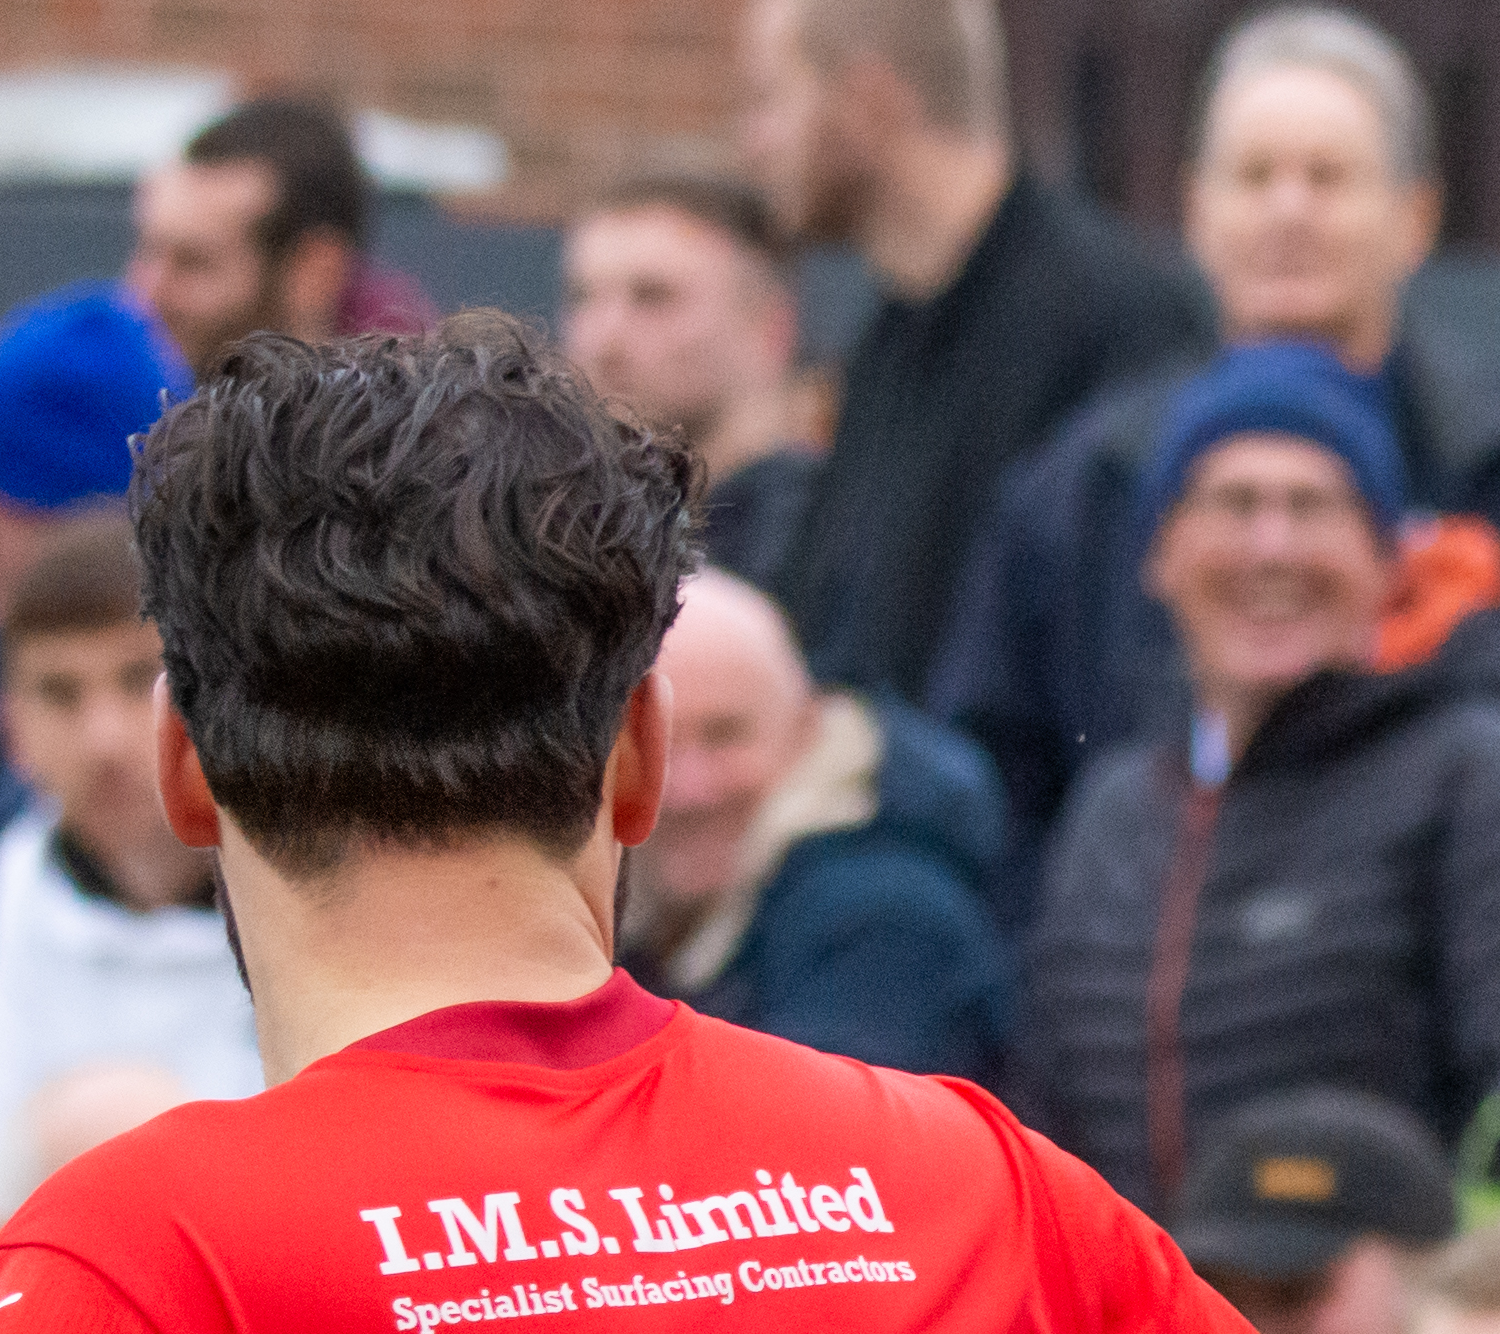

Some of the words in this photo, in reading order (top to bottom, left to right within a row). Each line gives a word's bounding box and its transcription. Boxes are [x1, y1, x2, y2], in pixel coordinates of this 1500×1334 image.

[359, 1187, 621, 1276] I.M.S.
[608, 1166, 896, 1255] Limited
[581, 1272, 735, 1309] Surfacing
[738, 1254, 918, 1294] Contractors
